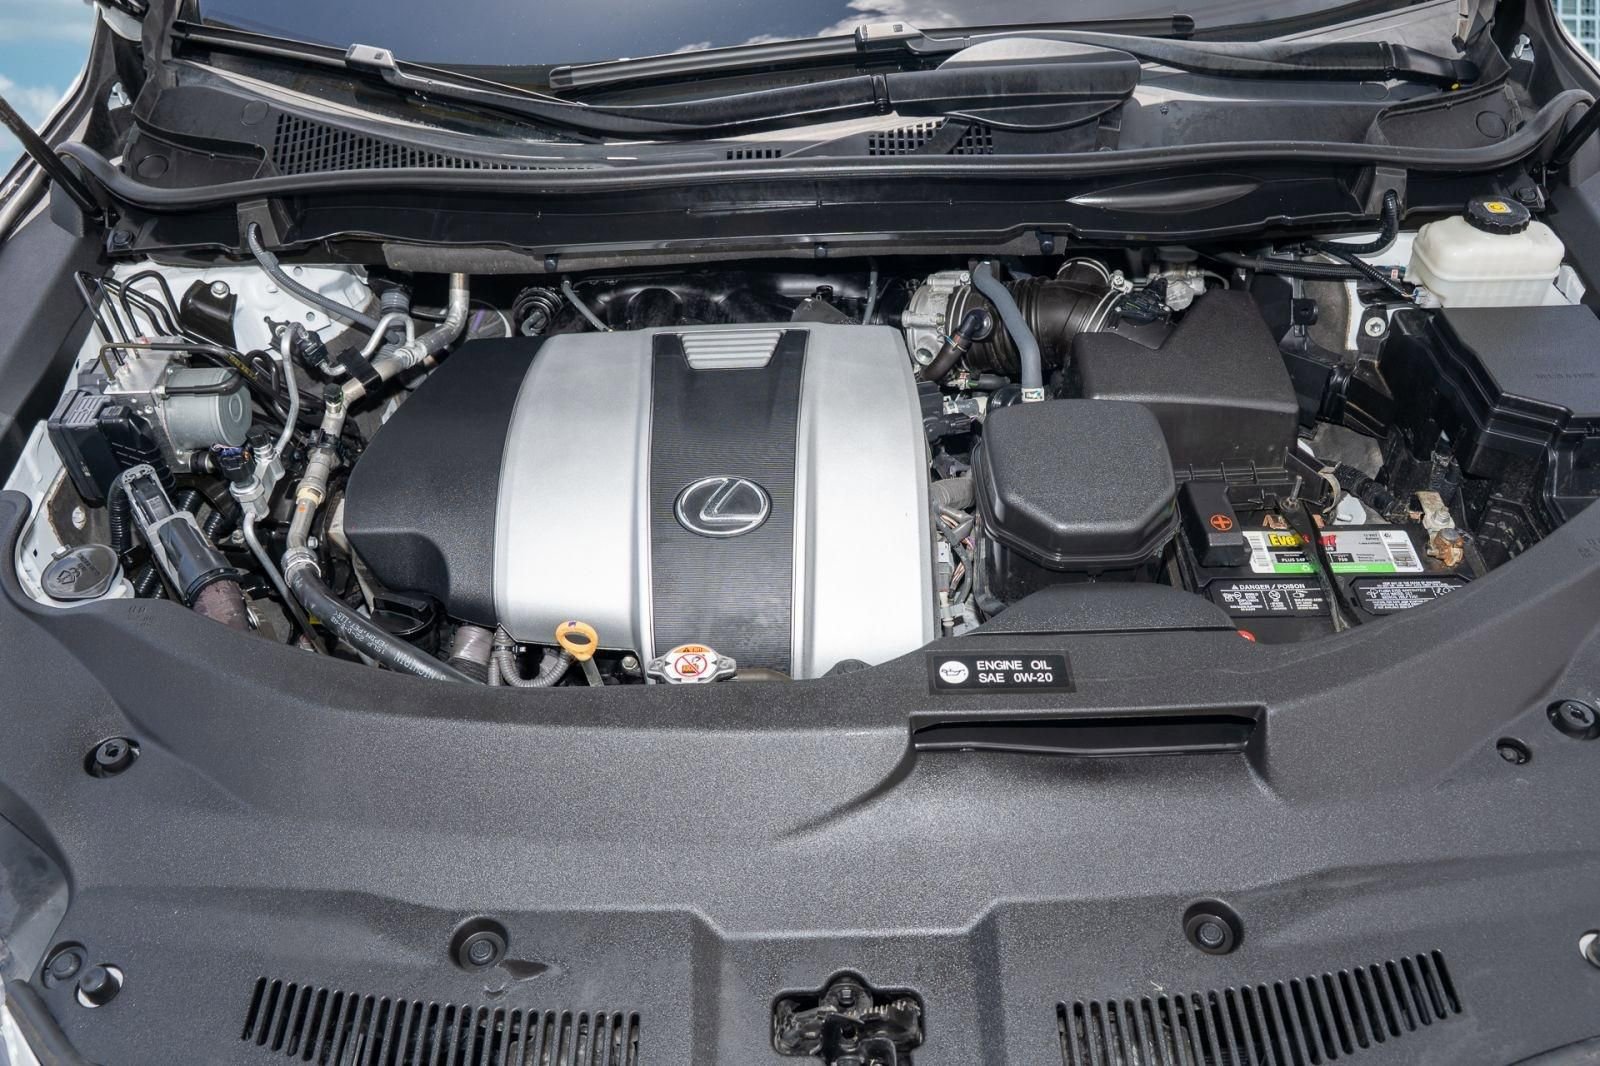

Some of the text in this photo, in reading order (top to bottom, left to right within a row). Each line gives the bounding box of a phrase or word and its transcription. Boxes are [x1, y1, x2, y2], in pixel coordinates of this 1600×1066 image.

[976, 660, 1052, 670] ENGINE OIL
[978, 672, 1053, 683] SAE 0W-20
